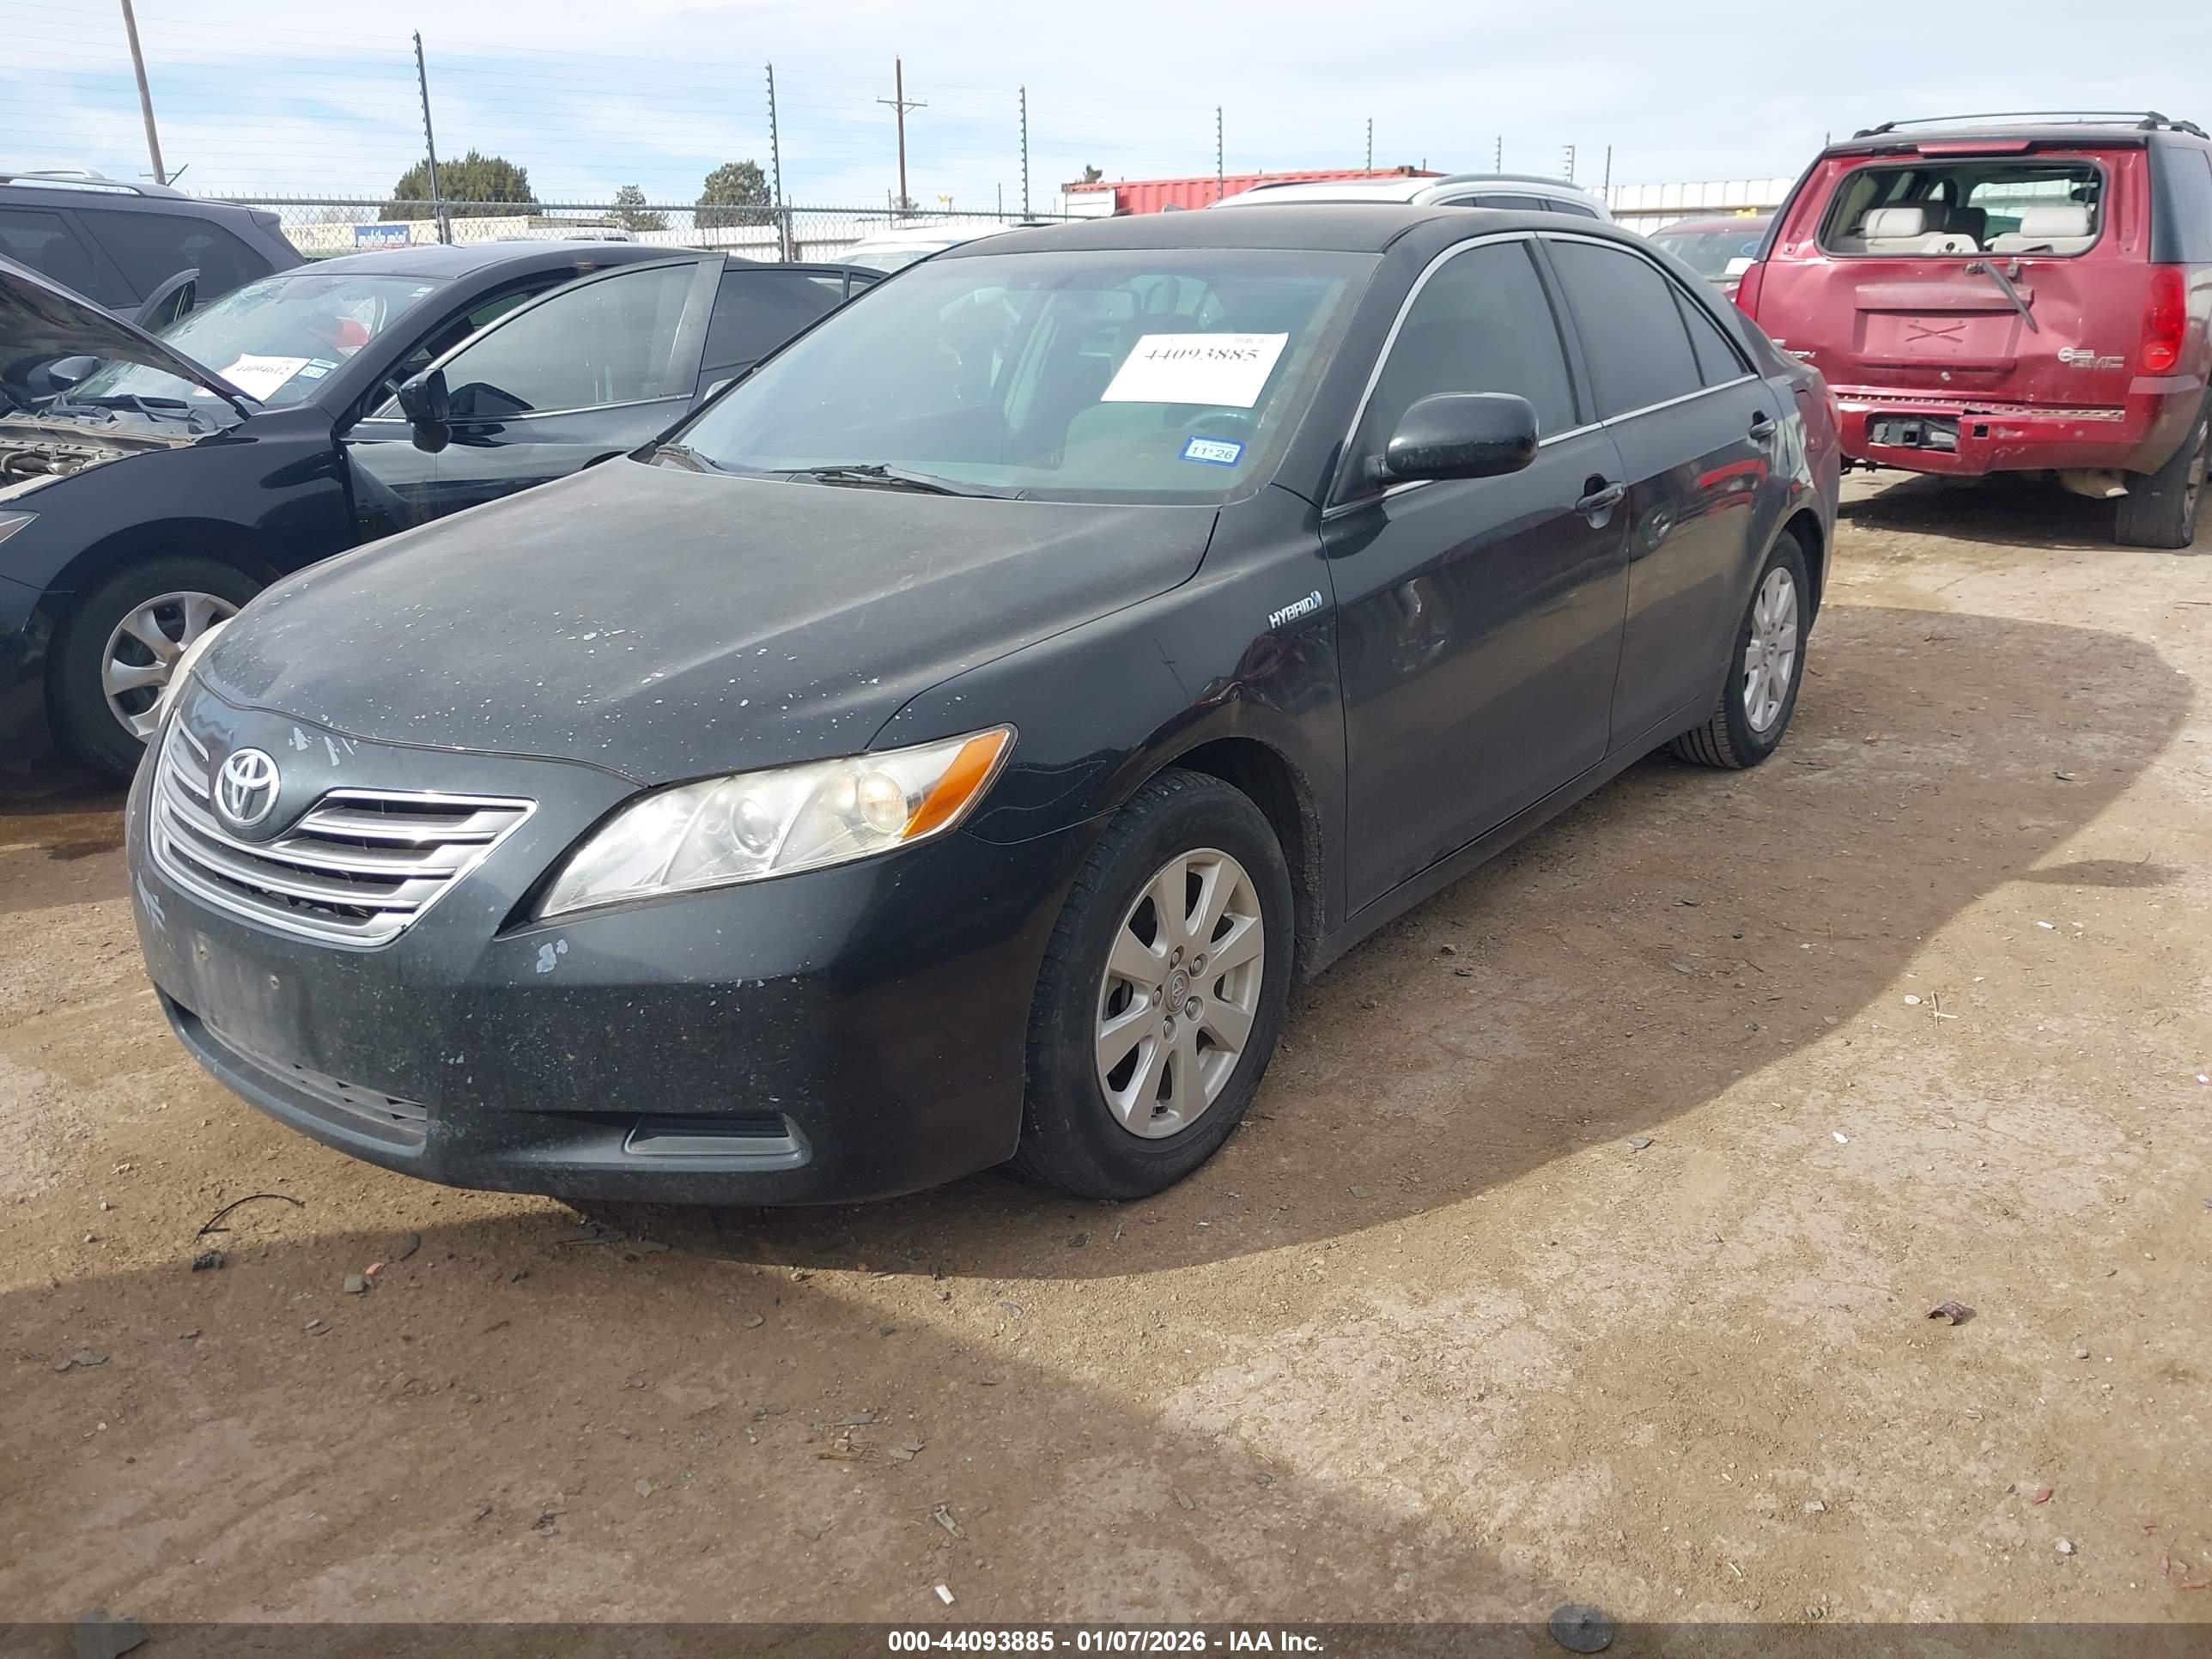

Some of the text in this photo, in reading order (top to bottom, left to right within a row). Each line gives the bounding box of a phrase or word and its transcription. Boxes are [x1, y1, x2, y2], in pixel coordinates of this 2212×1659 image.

[1144, 348, 1260, 362] 44093885
[2069, 356, 2125, 368] GMC
[1267, 597, 1315, 629] HYBRID
